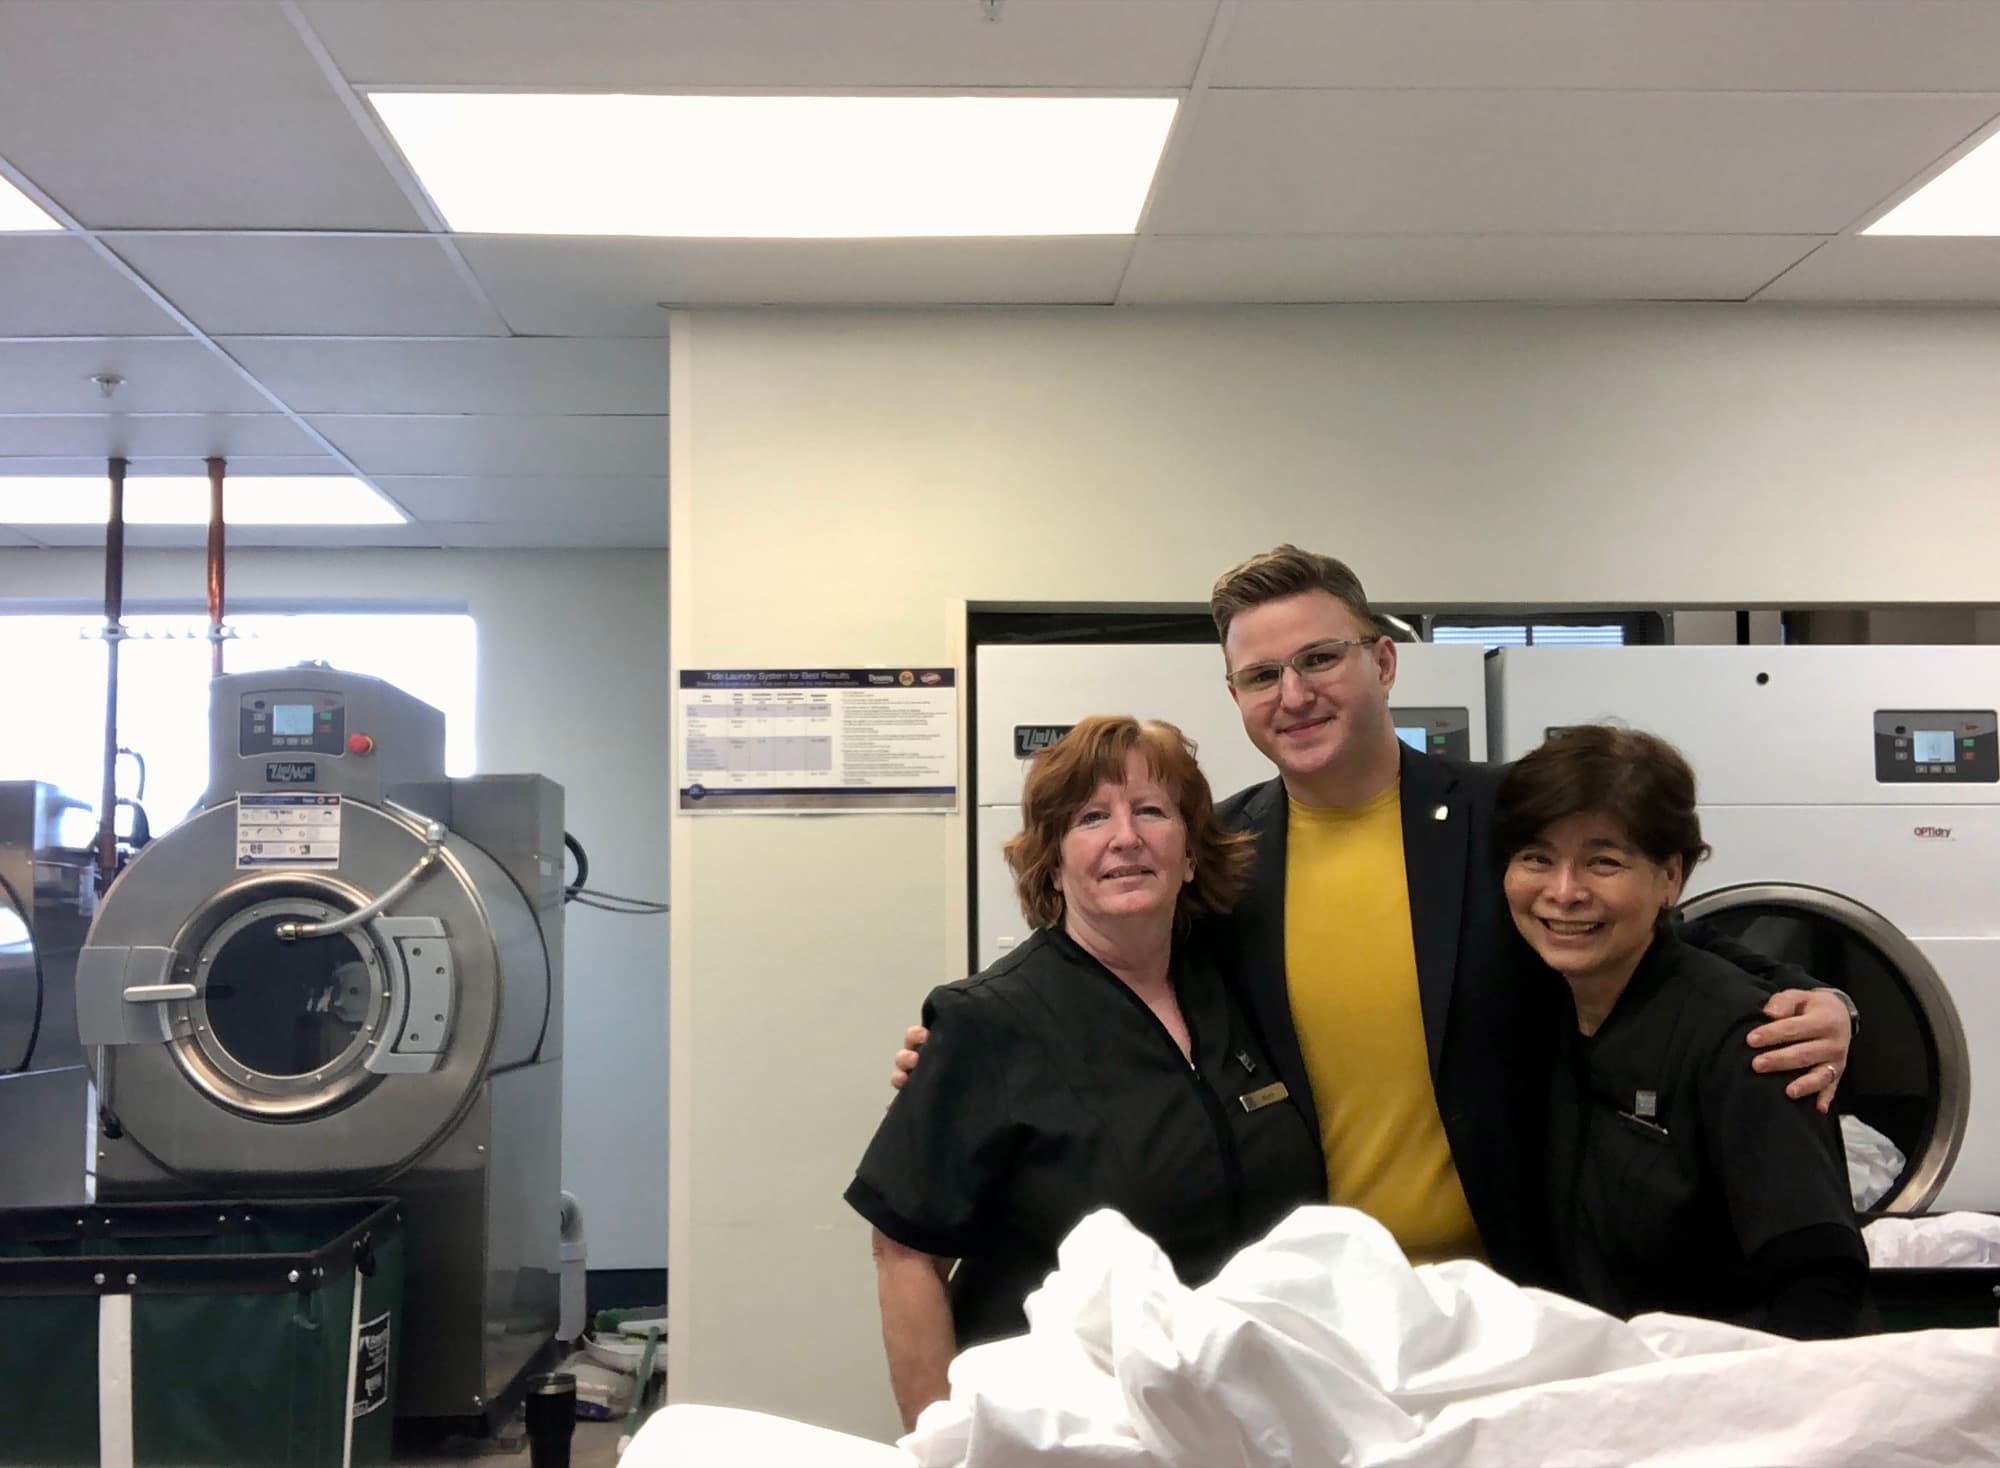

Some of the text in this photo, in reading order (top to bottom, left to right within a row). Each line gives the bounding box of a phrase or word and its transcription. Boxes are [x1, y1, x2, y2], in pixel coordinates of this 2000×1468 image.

[724, 672, 756, 682] Laundry
[758, 672, 788, 682] System
[789, 671, 799, 680] for
[801, 671, 819, 680] Best
[821, 671, 850, 680] Results
